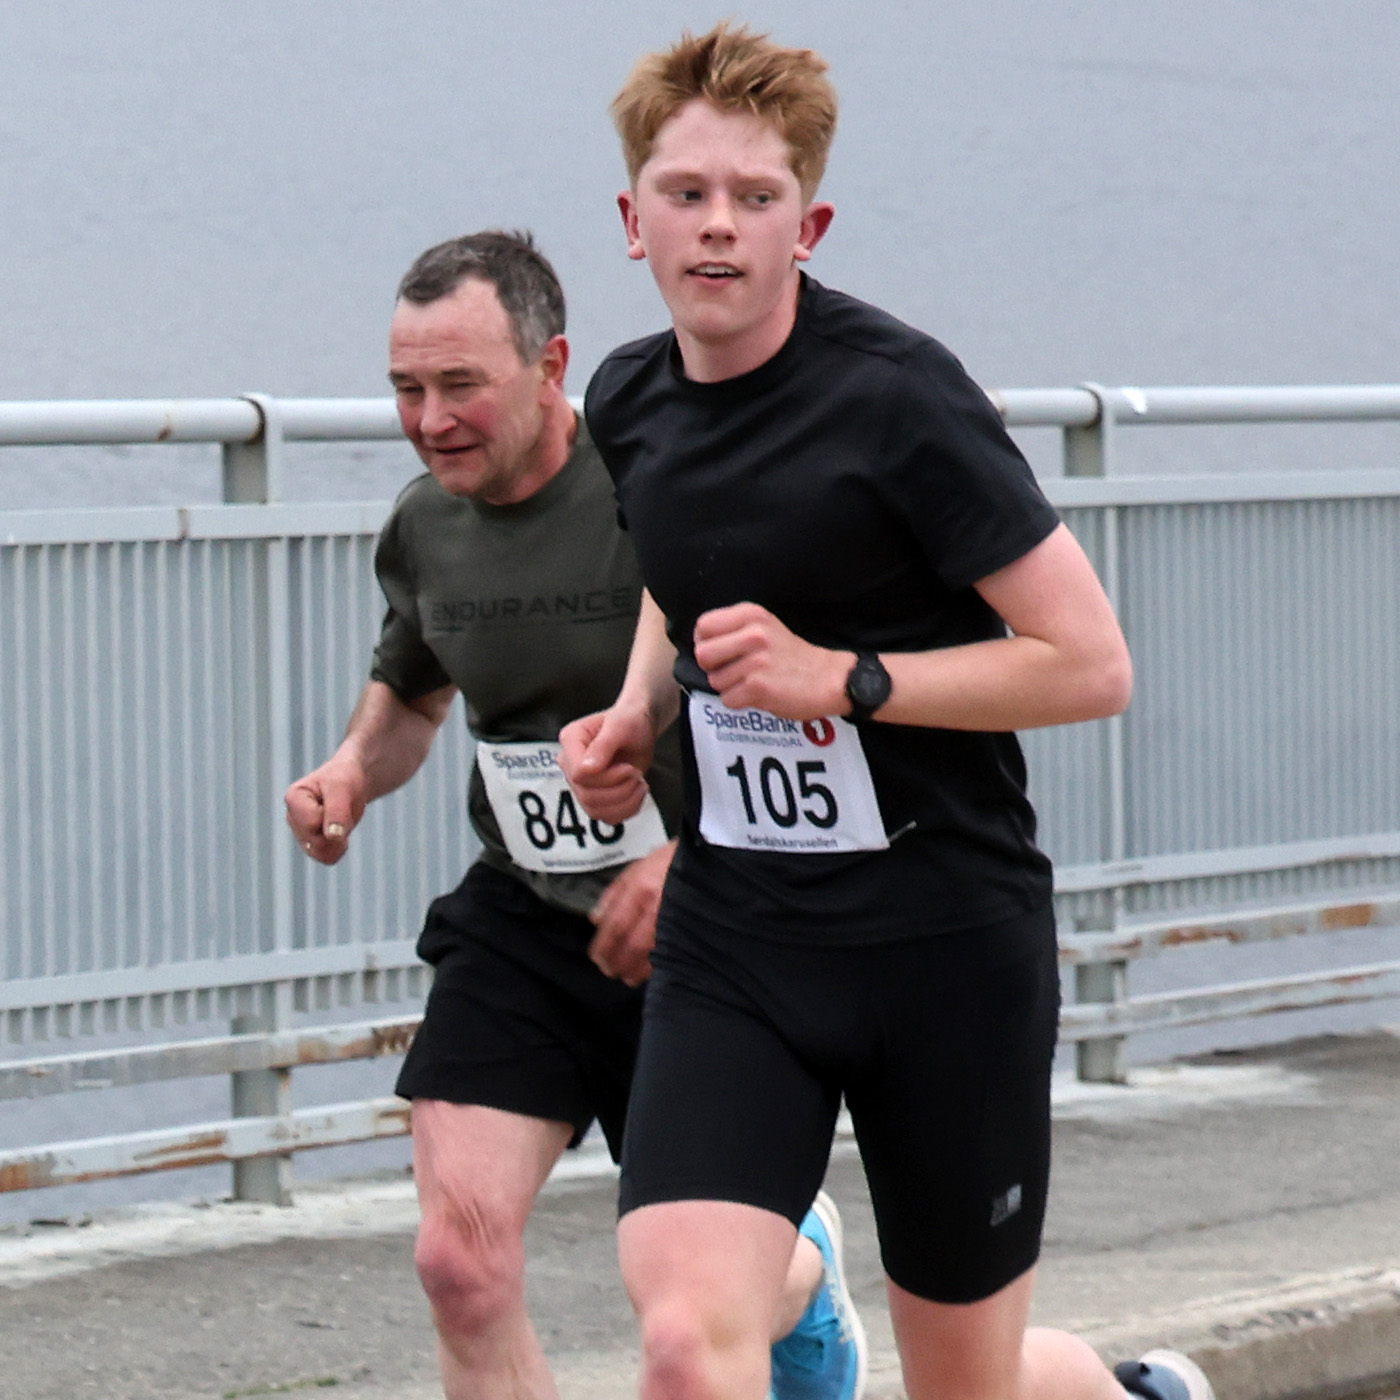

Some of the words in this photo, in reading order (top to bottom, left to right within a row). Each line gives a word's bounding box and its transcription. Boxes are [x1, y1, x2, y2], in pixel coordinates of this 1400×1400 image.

[432, 587, 632, 621] ENDURANCE
[703, 705, 799, 734] SpareBank
[727, 755, 839, 829] 105
